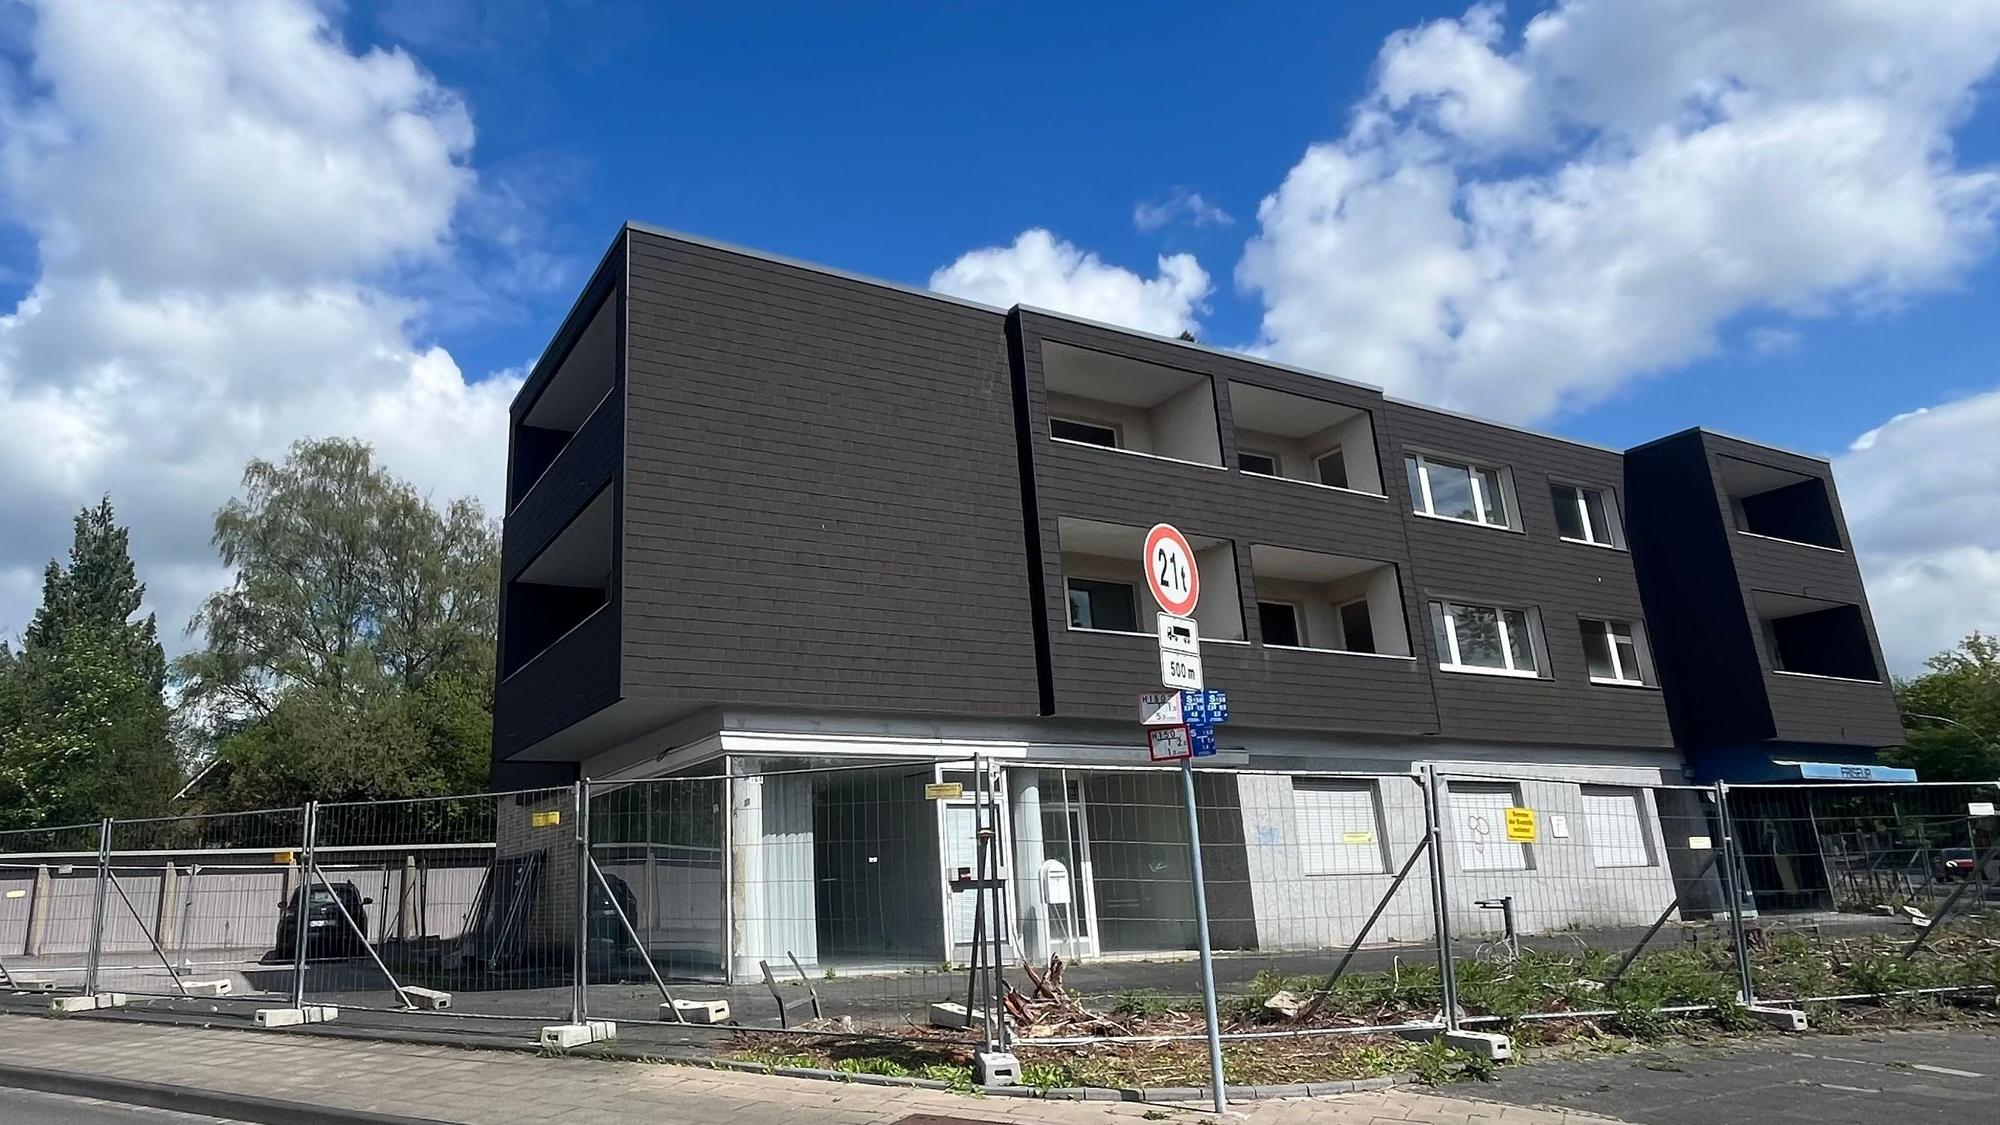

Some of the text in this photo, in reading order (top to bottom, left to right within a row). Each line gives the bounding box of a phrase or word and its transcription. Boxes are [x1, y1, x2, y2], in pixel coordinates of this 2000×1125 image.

[1170, 661, 1196, 681] 500 m
[1142, 694, 1166, 703] H150
[1152, 729, 1176, 740] H150
